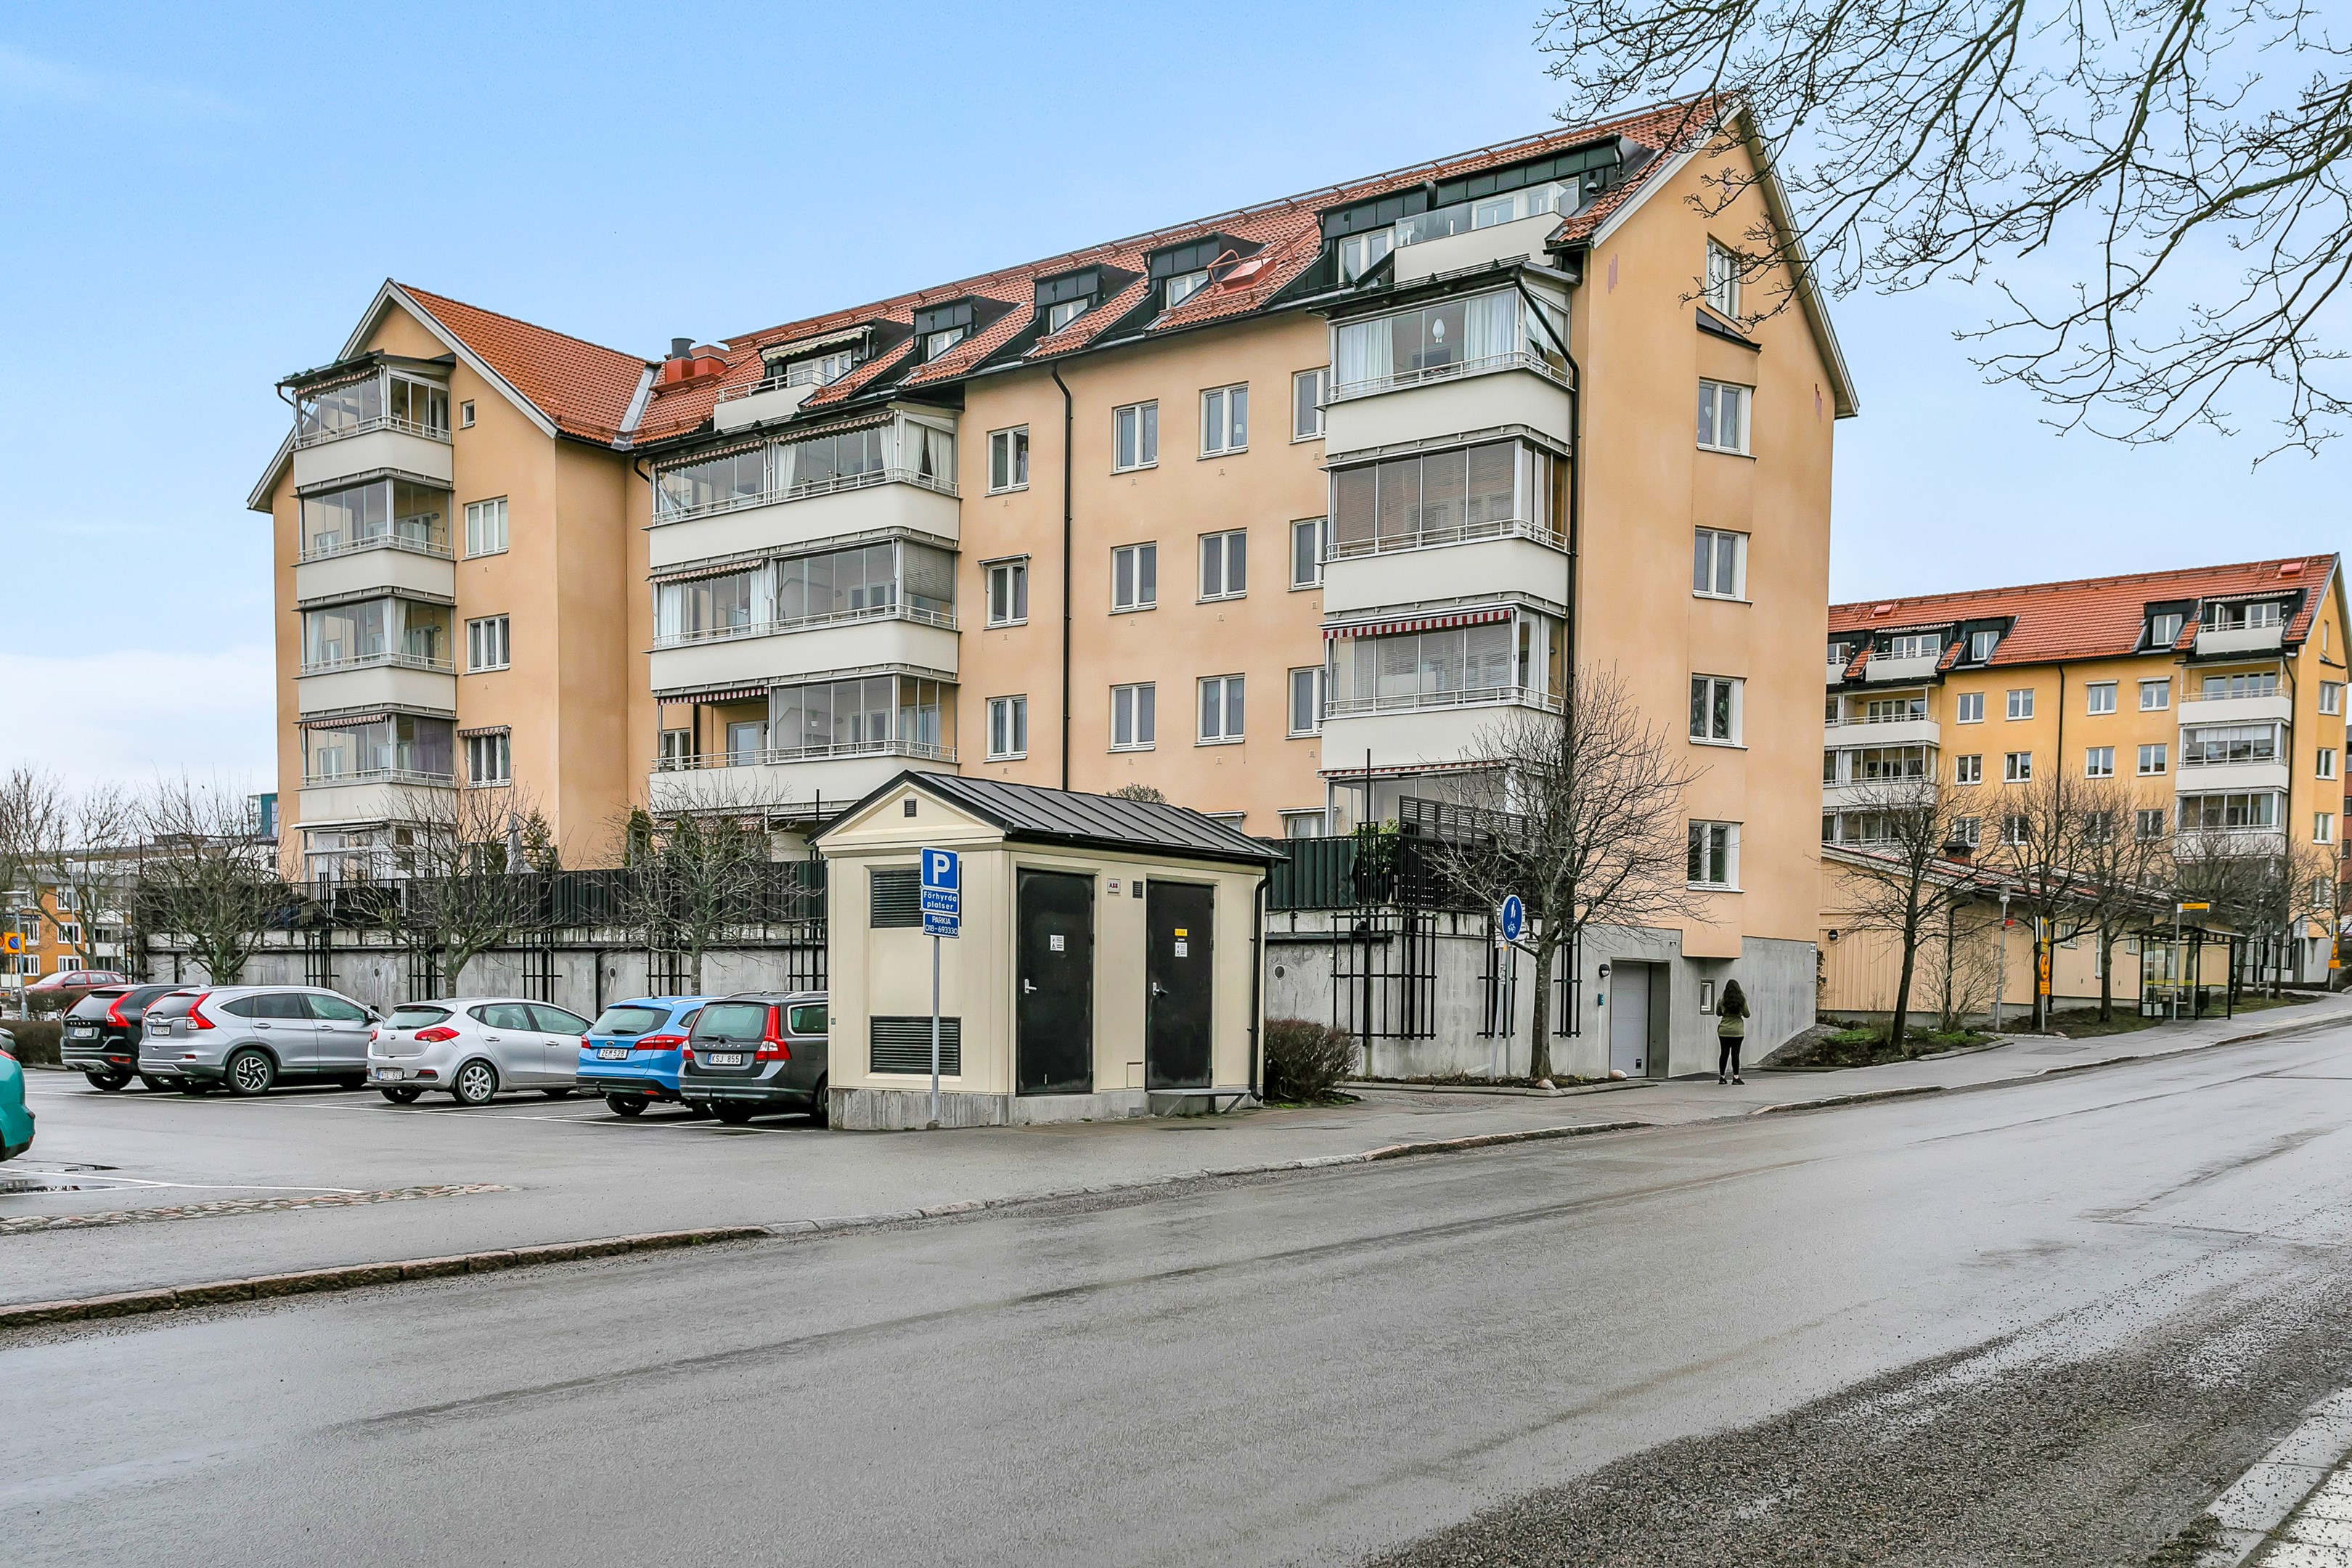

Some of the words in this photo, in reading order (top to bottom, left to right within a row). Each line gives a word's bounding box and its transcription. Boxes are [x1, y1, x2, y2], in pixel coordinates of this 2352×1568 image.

[933, 853, 950, 884] P
[923, 891, 957, 902] Förhyrda
[927, 901, 953, 910] platser
[932, 915, 951, 925] PARKIA
[925, 924, 958, 935] 018-693330
